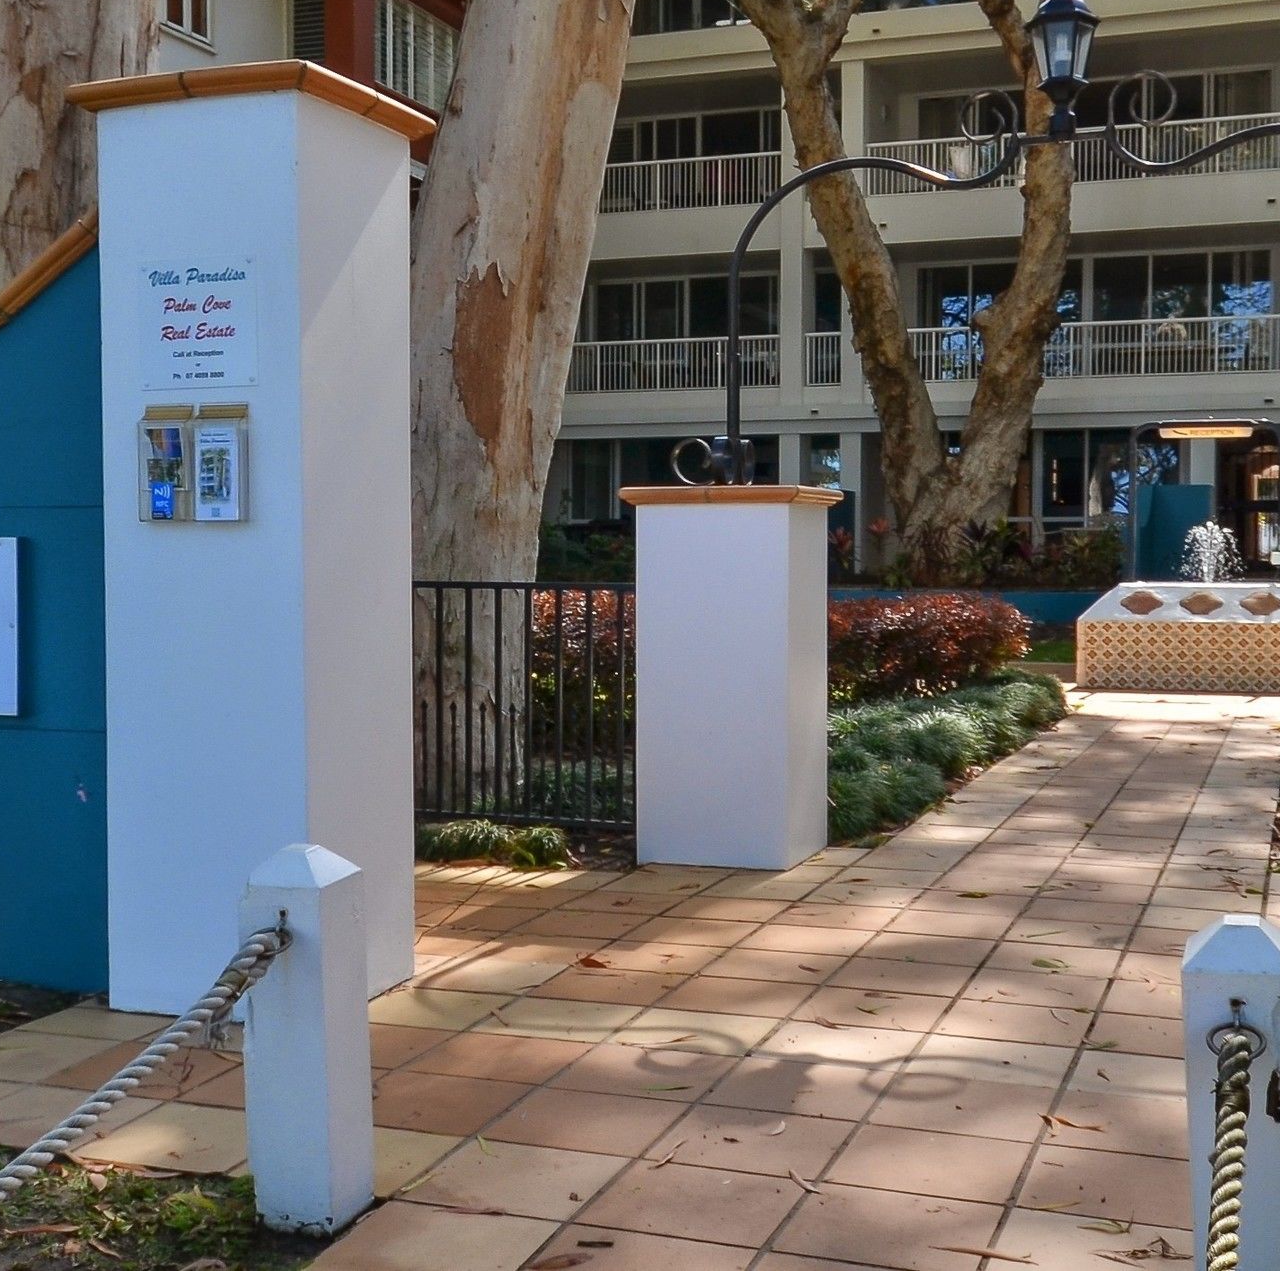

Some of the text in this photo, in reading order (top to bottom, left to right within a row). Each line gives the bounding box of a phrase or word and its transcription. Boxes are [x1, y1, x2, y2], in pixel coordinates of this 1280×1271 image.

[148, 267, 246, 287] Villa Paradiso
[163, 294, 231, 315] Palm Cove
[161, 322, 236, 341] Real Estate
